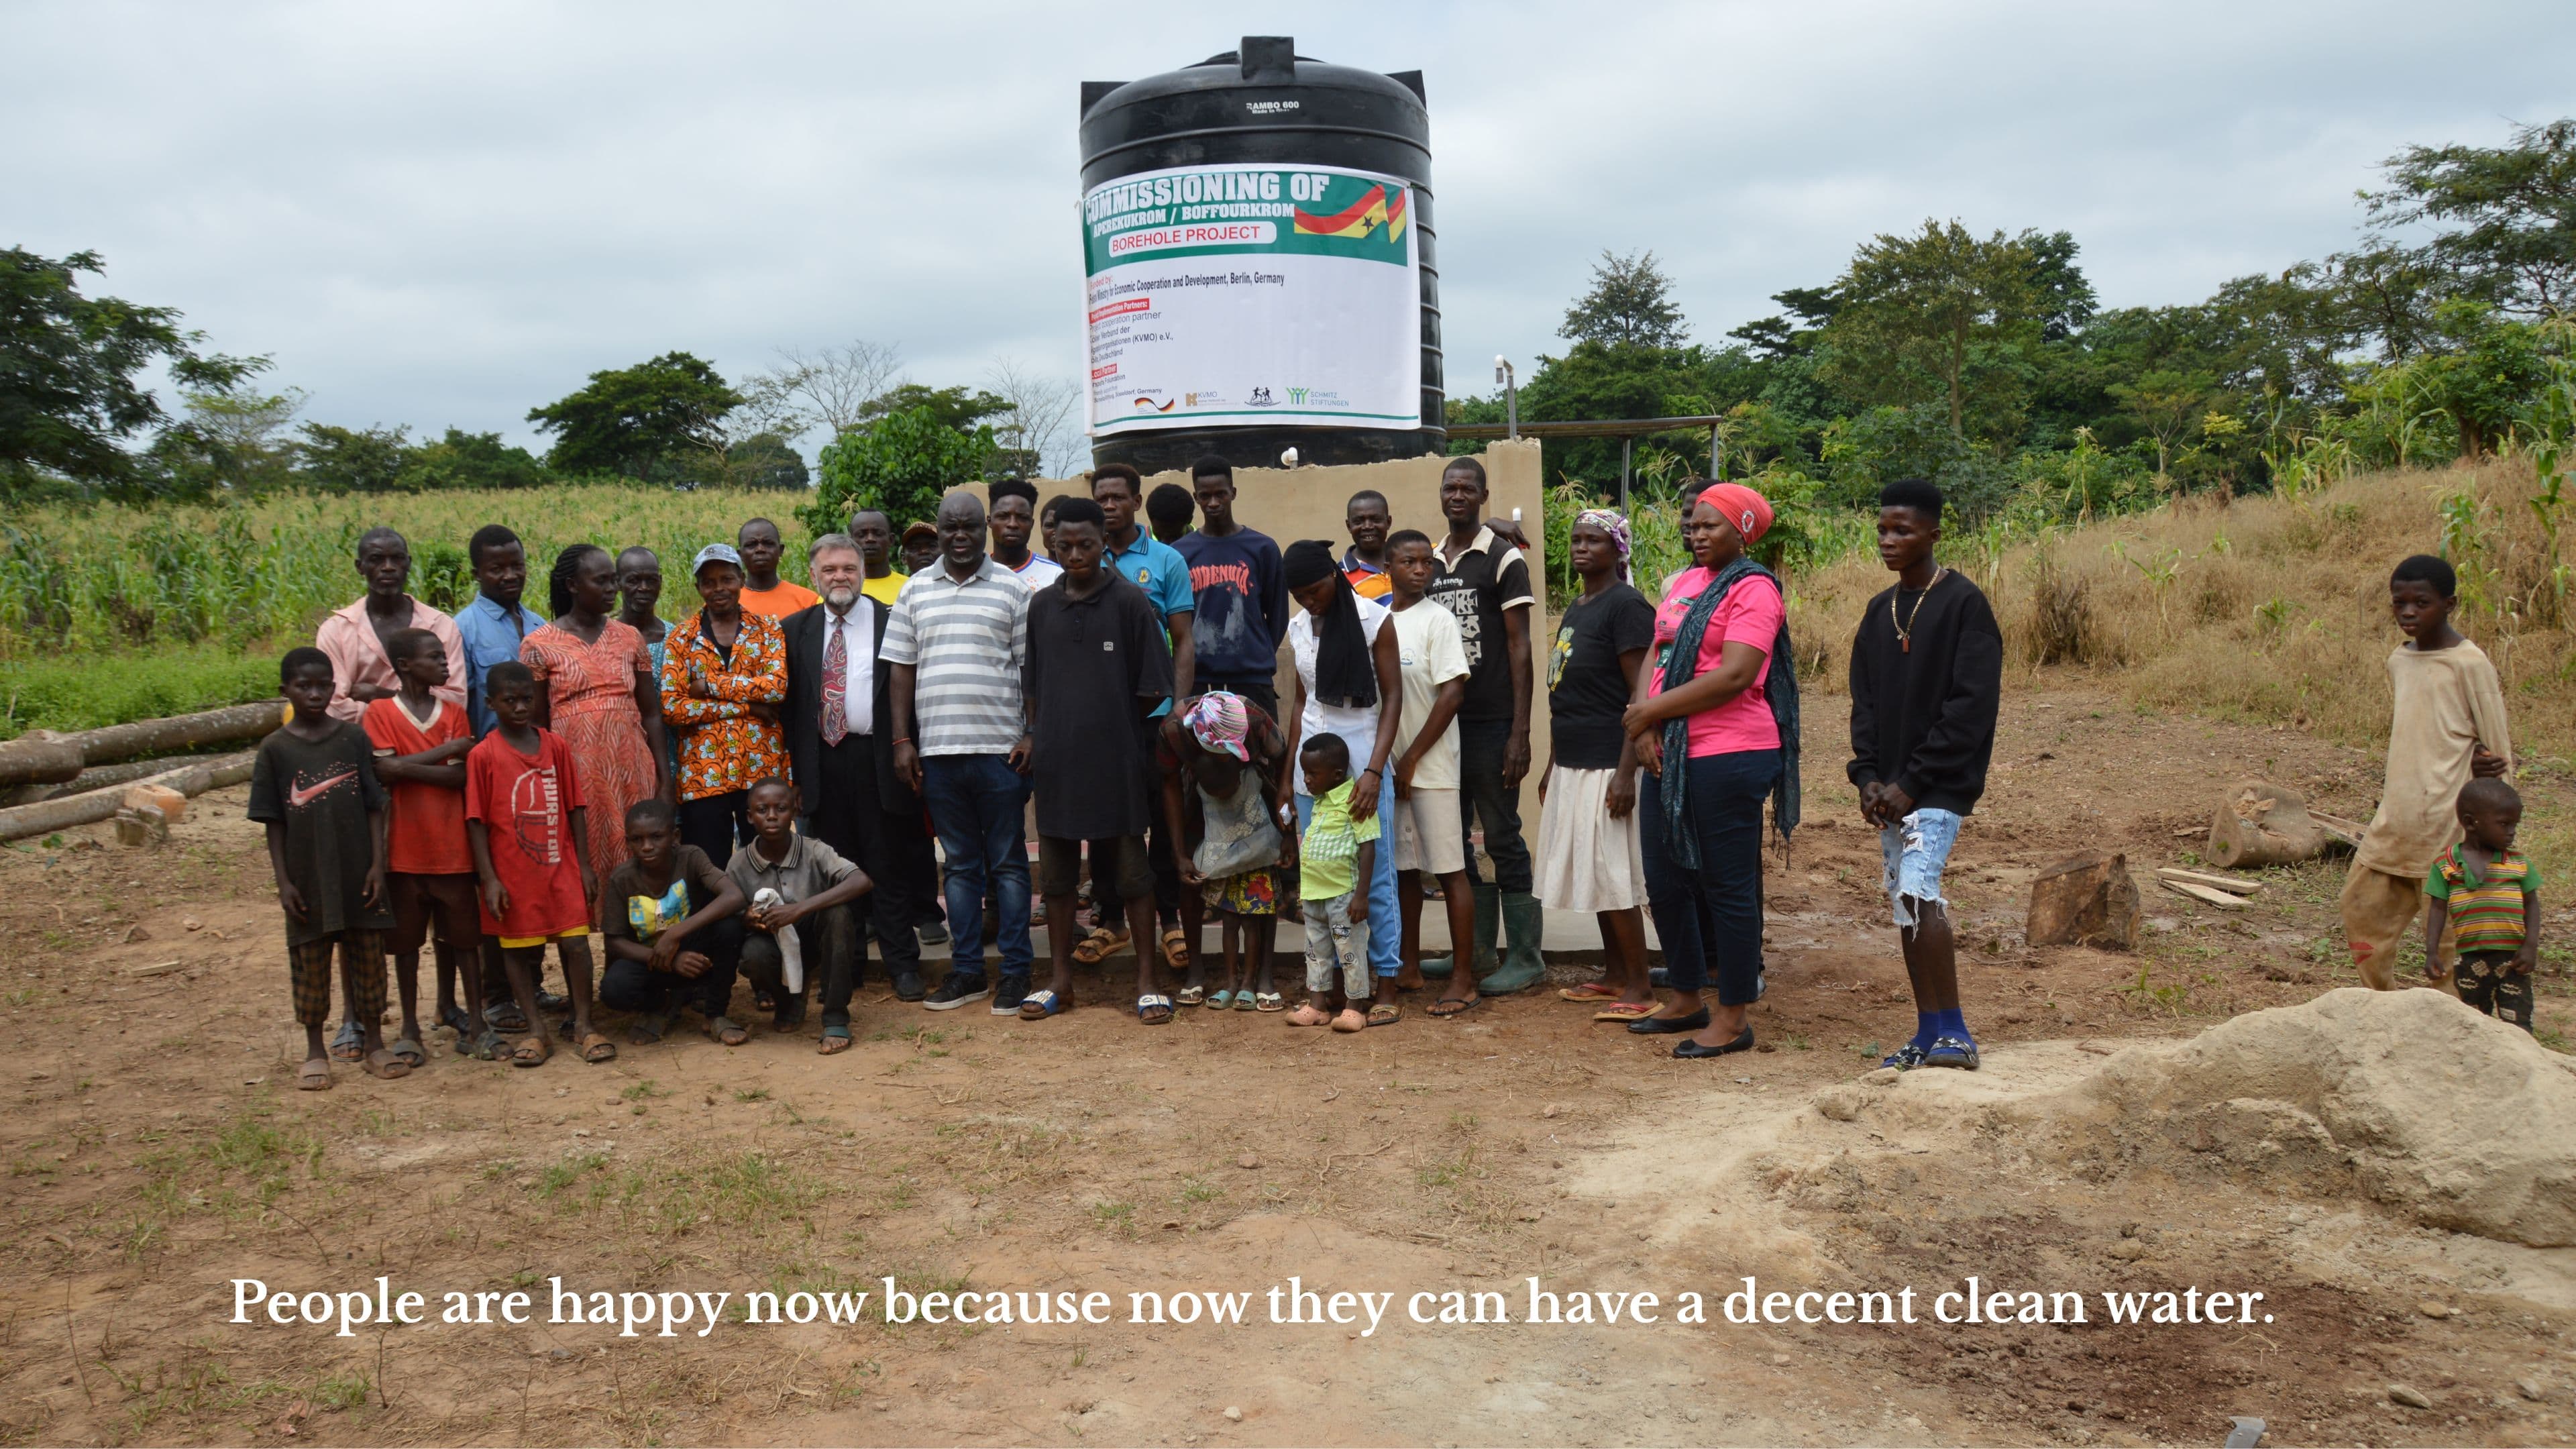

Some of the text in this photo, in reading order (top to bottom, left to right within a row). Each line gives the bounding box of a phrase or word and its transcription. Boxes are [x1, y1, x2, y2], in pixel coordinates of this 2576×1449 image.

[1086, 172, 1330, 225] COMMISSIONING OF
[1182, 203, 1295, 221] BOFFOURKROM
[1112, 226, 1260, 252] BOREHOLE PROJECT
[1114, 281, 1136, 295] Economic
[1136, 276, 1171, 293] Cooperation
[1173, 275, 1183, 288] and
[1185, 274, 1228, 288] Development,
[1230, 272, 1252, 286] Berlin,
[1254, 271, 1285, 286] Germany
[1132, 311, 1162, 322] partner
[1120, 325, 1130, 334] der
[1132, 333, 1158, 344] (KVMO)
[541, 765, 561, 863] THURSTON
